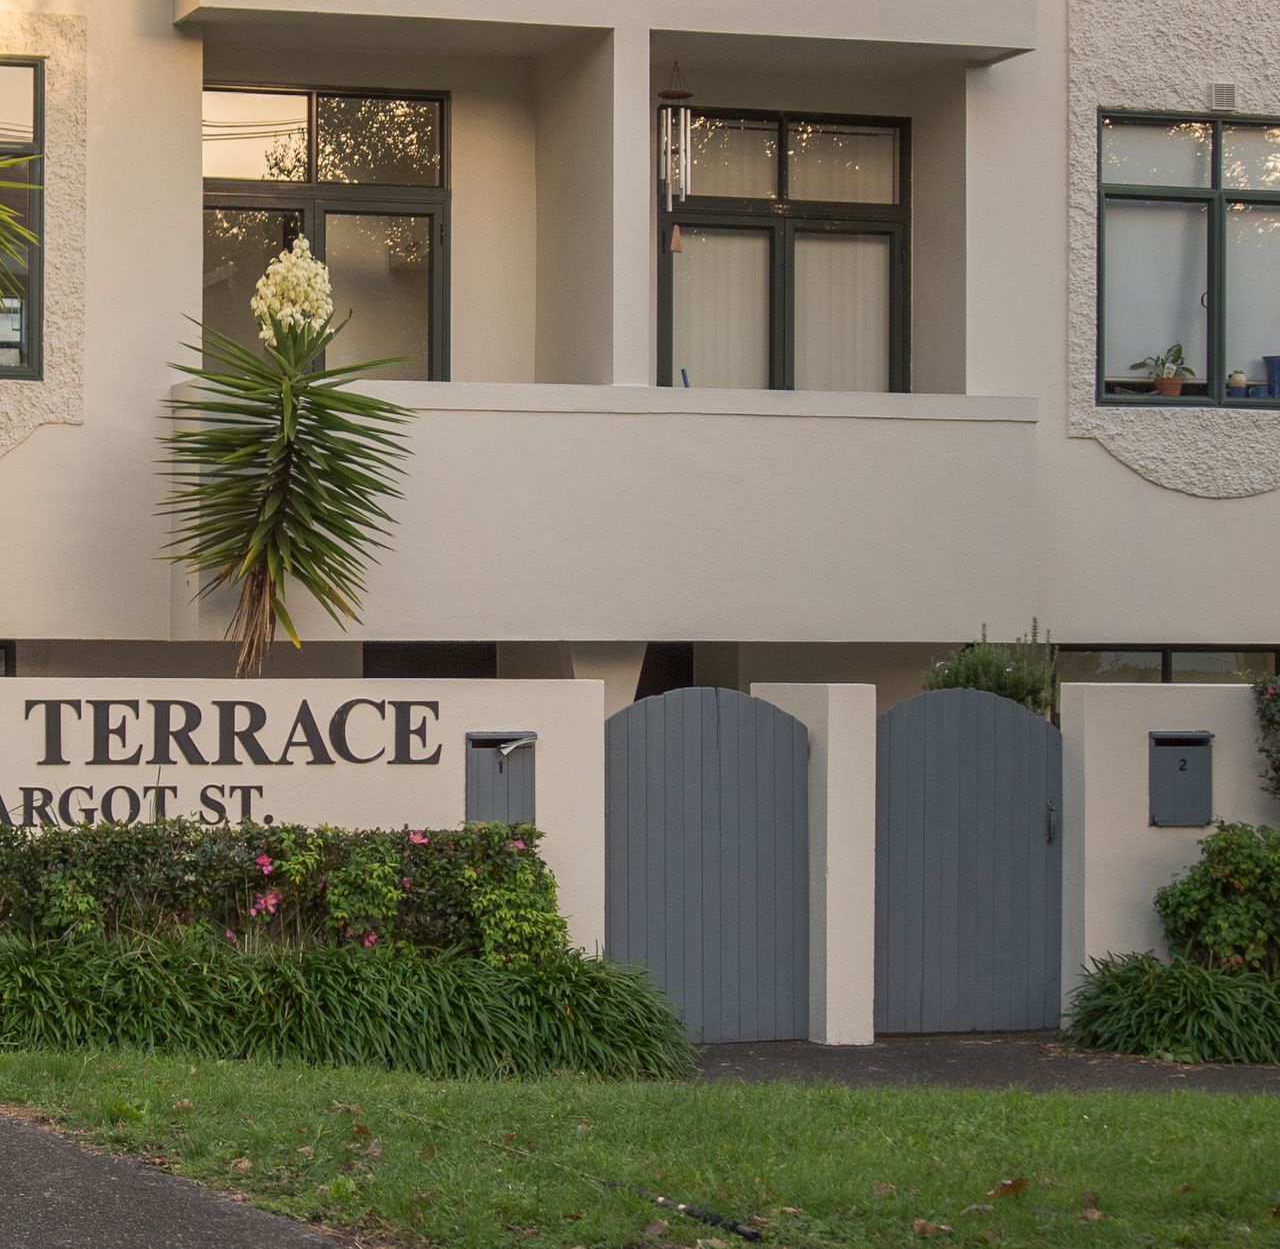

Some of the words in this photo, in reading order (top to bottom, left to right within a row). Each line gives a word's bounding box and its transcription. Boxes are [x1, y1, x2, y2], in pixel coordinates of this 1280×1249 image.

[24, 698, 443, 766] TERRACE
[497, 759, 504, 775] 1
[1178, 758, 1188, 771] 2
[198, 784, 275, 826] ST.
